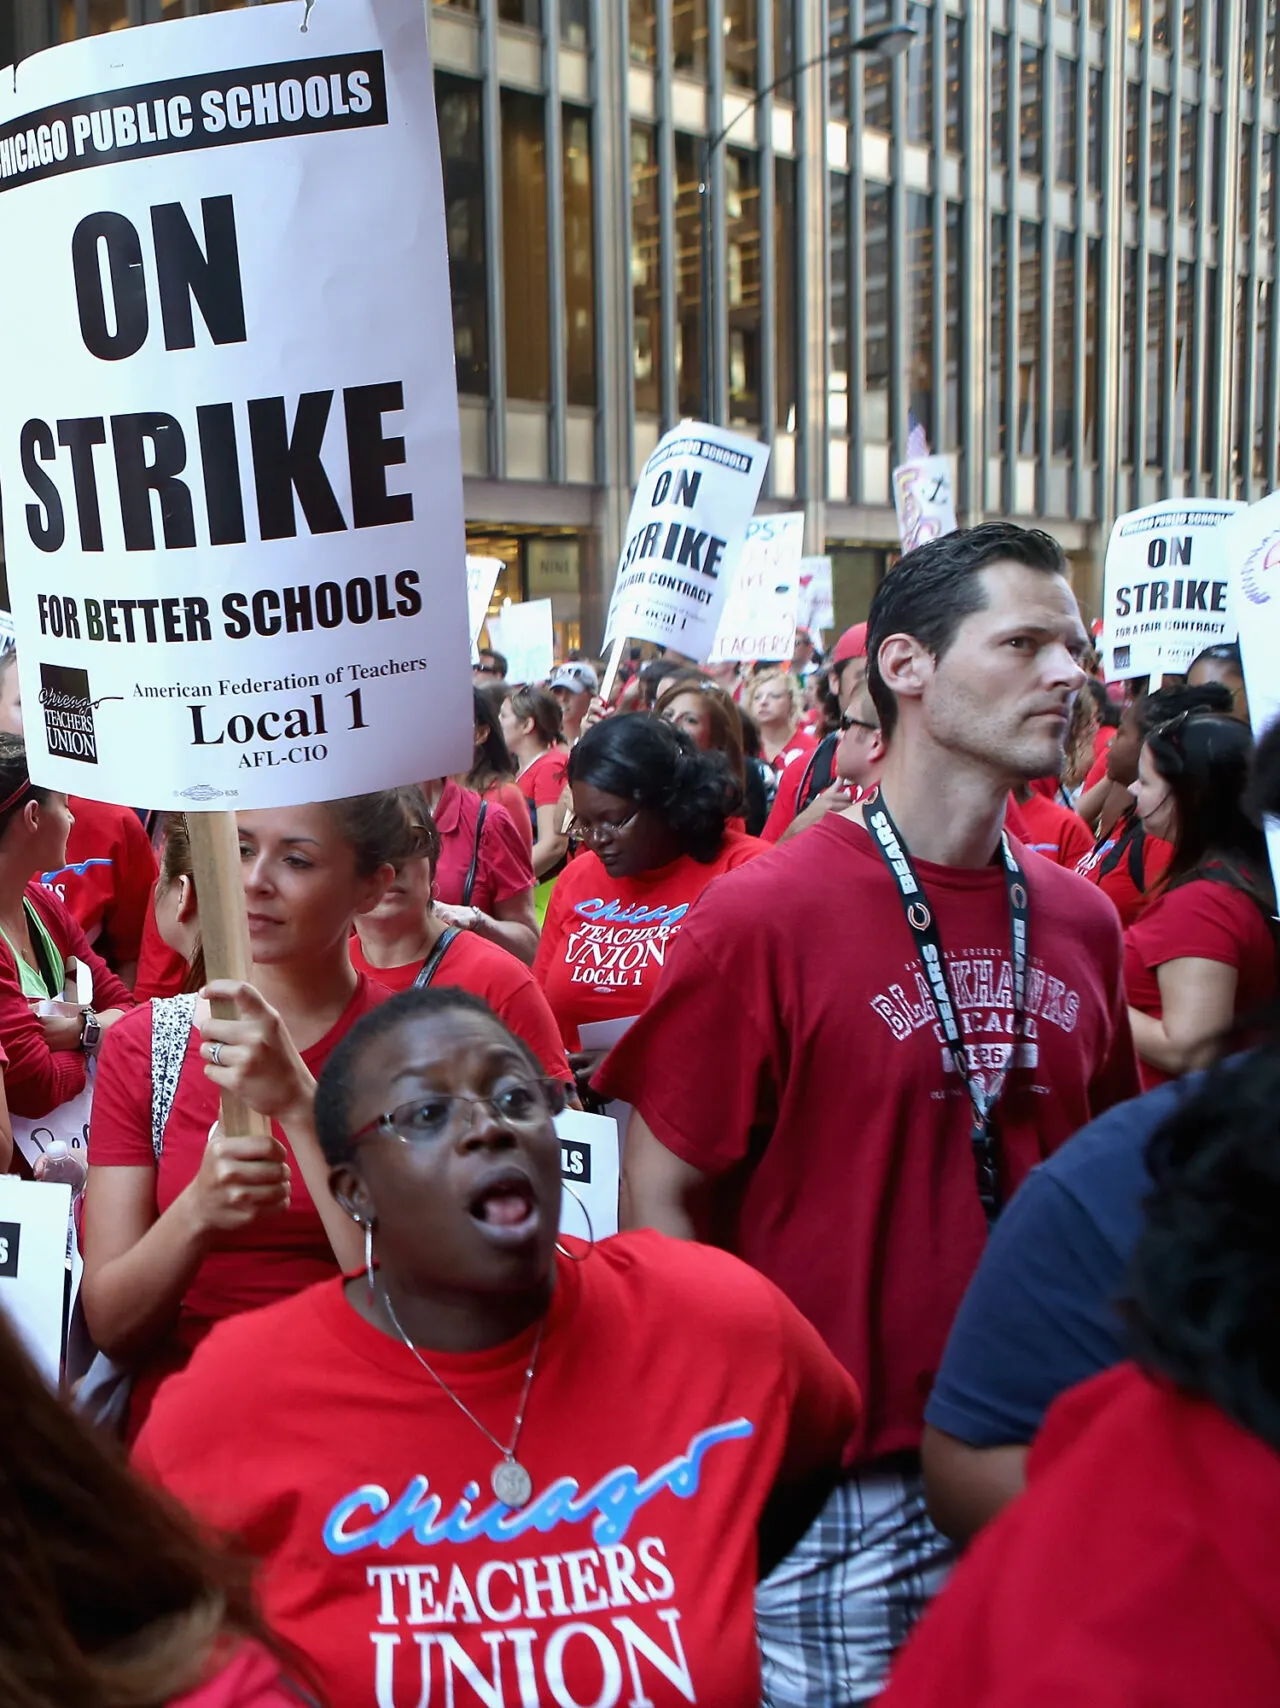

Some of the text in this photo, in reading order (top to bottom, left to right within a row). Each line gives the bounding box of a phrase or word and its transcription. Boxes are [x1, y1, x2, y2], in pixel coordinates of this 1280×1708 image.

[73, 95, 193, 157] PUBLIC
[202, 70, 373, 133] SCHOOLS
[72, 194, 247, 361] ON
[20, 381, 414, 552] STRIKE
[652, 469, 702, 508] ON
[622, 521, 727, 580] STRIKE
[1148, 536, 1193, 568] ON
[37, 569, 422, 643] FOR BETTER SCHOOLS
[649, 572, 713, 605] CONTRACT
[1116, 579, 1229, 617] STRIKE
[1141, 621, 1161, 633] FAIR
[1165, 620, 1225, 634] CONTRACT
[132, 656, 428, 699] American Federation of Teachers
[38, 687, 124, 716] Chicago
[45, 709, 93, 733] TEACHERS
[186, 687, 370, 746] Local 1
[47, 726, 96, 757] UNION
[238, 744, 328, 769] AFL-CIO
[870, 810, 918, 895] BEARS
[565, 933, 669, 970] UNION
[571, 966, 642, 986] LOCAL 1
[922, 943, 959, 1041] BEARS
[870, 959, 1081, 1041] BLAKHAWKS
[561, 1148, 584, 1175] LS
[323, 1418, 754, 1555] Chicago
[366, 1537, 676, 1625] TEACHERS
[369, 1608, 698, 1708] UNION
